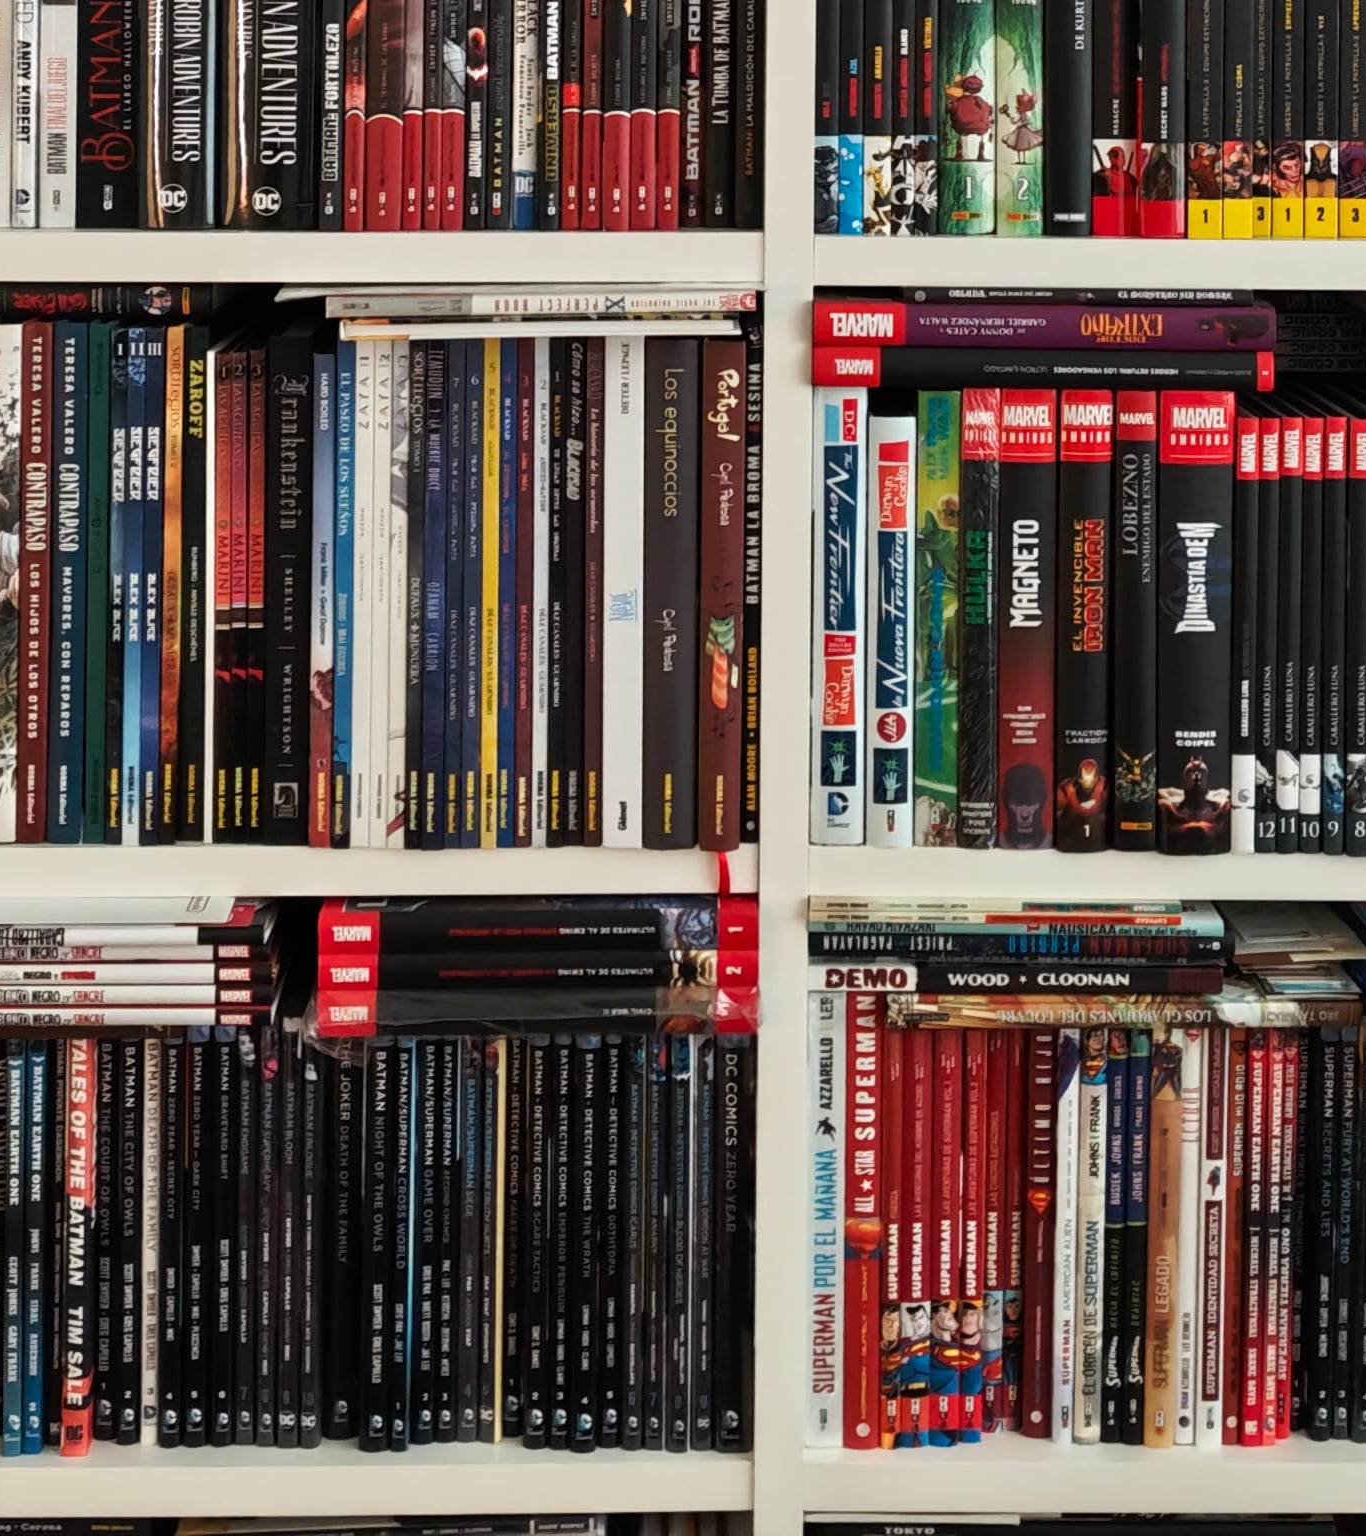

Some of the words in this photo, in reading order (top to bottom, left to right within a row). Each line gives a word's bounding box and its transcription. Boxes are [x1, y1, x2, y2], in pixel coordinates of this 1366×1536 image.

[172, 53, 202, 163] ADVENTURES
[664, 368, 685, 401] Los
[709, 368, 740, 442] Portugal
[655, 408, 681, 518] equinoccios
[1009, 519, 1043, 629] MAGNETO
[825, 969, 907, 990] DEMO
[948, 972, 1010, 986] WOOD
[1037, 972, 1130, 987] CLOONAN
[813, 1149, 837, 1216] MAÑANA
[815, 1221, 836, 1241] EL
[814, 1246, 835, 1288] POR
[813, 1294, 835, 1394] SUPERMAN
